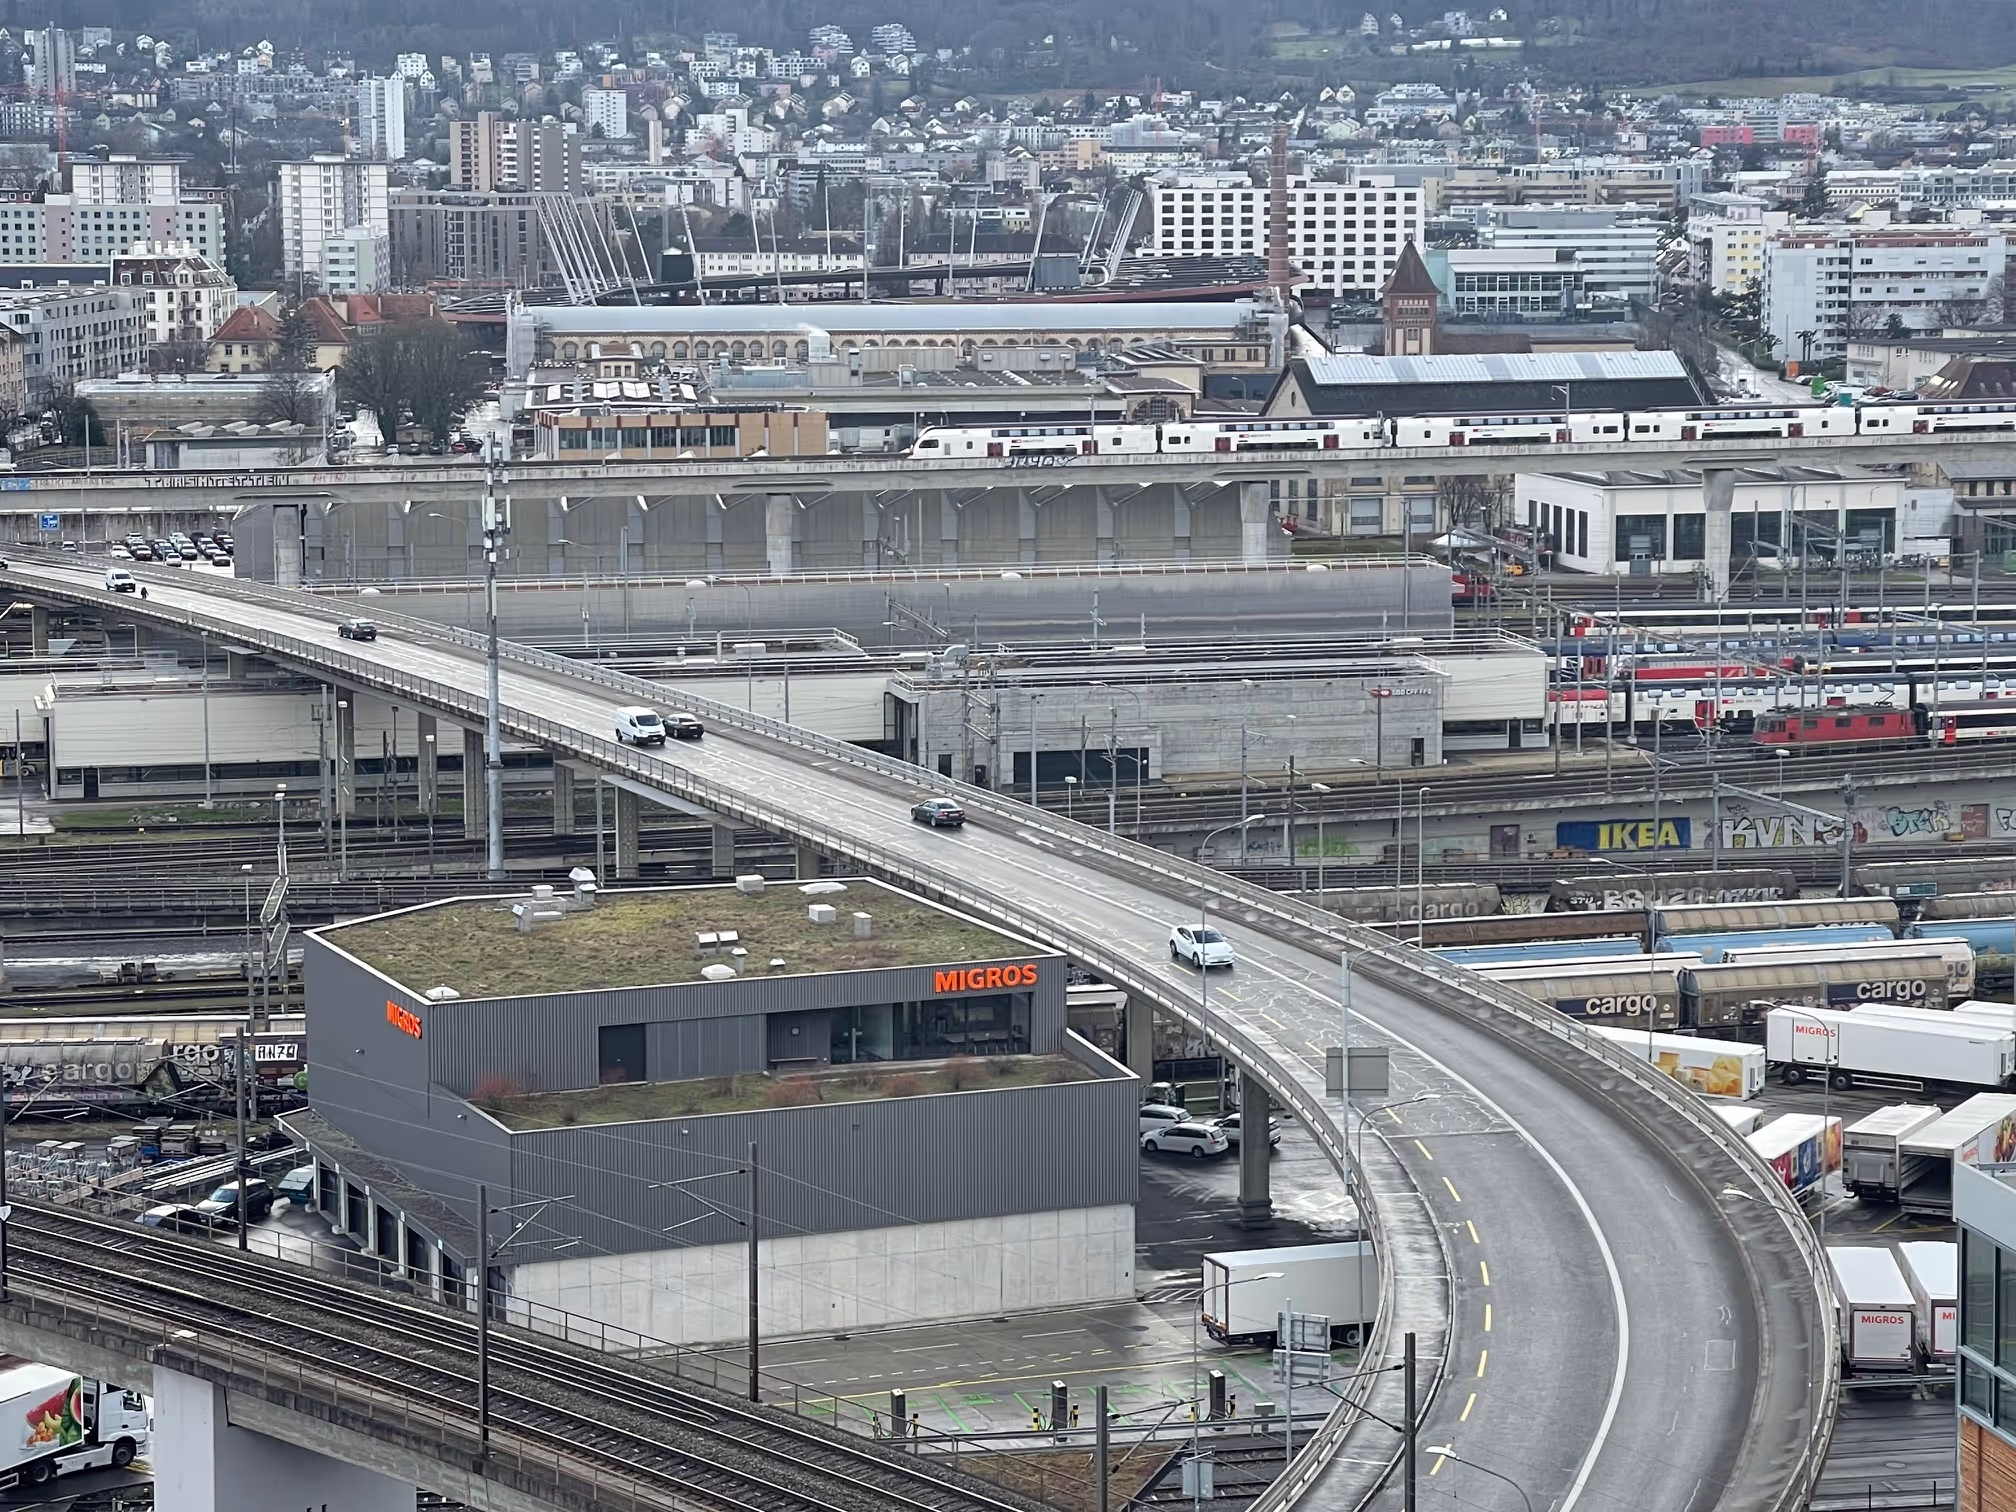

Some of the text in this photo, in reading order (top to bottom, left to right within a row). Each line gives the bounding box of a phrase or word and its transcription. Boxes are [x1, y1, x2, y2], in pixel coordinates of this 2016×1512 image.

[1598, 821, 1680, 850] IKEA
[1409, 901, 1479, 919] cargo
[935, 963, 1038, 993] MIGROS
[1856, 979, 1927, 1001] cargo
[1586, 994, 1658, 1017] cargo
[386, 1000, 422, 1040] MIGROS
[1795, 1025, 1836, 1038] MIGROS
[1861, 1315, 1904, 1324] MIGROS
